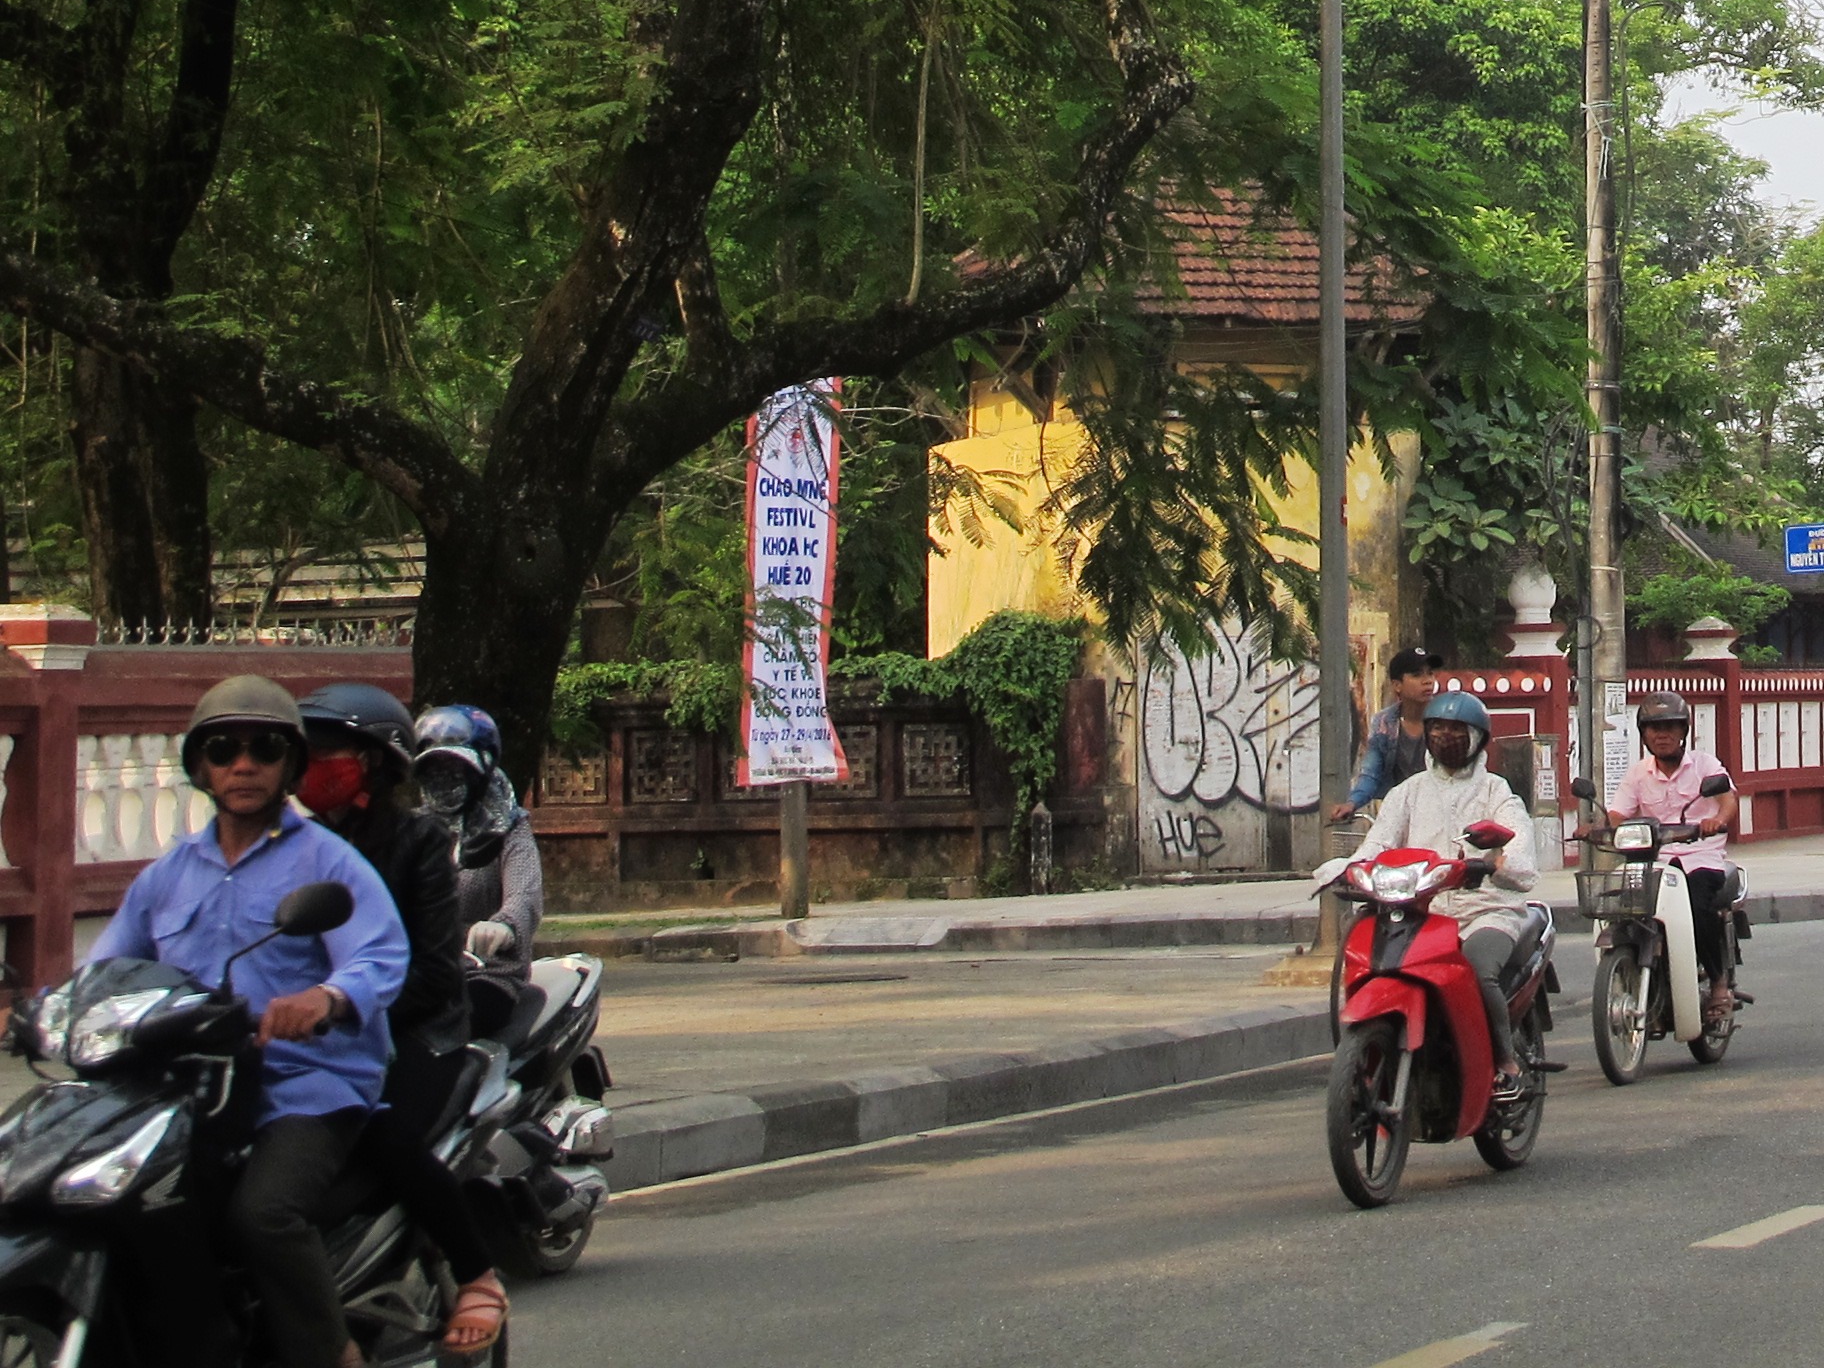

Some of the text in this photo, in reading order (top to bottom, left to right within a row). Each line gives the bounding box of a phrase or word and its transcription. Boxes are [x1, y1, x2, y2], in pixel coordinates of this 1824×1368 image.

[763, 536, 799, 556] KHOA
[768, 559, 791, 586] HUẾ
[773, 669, 780, 681] Y
[784, 664, 798, 681] TẾ
